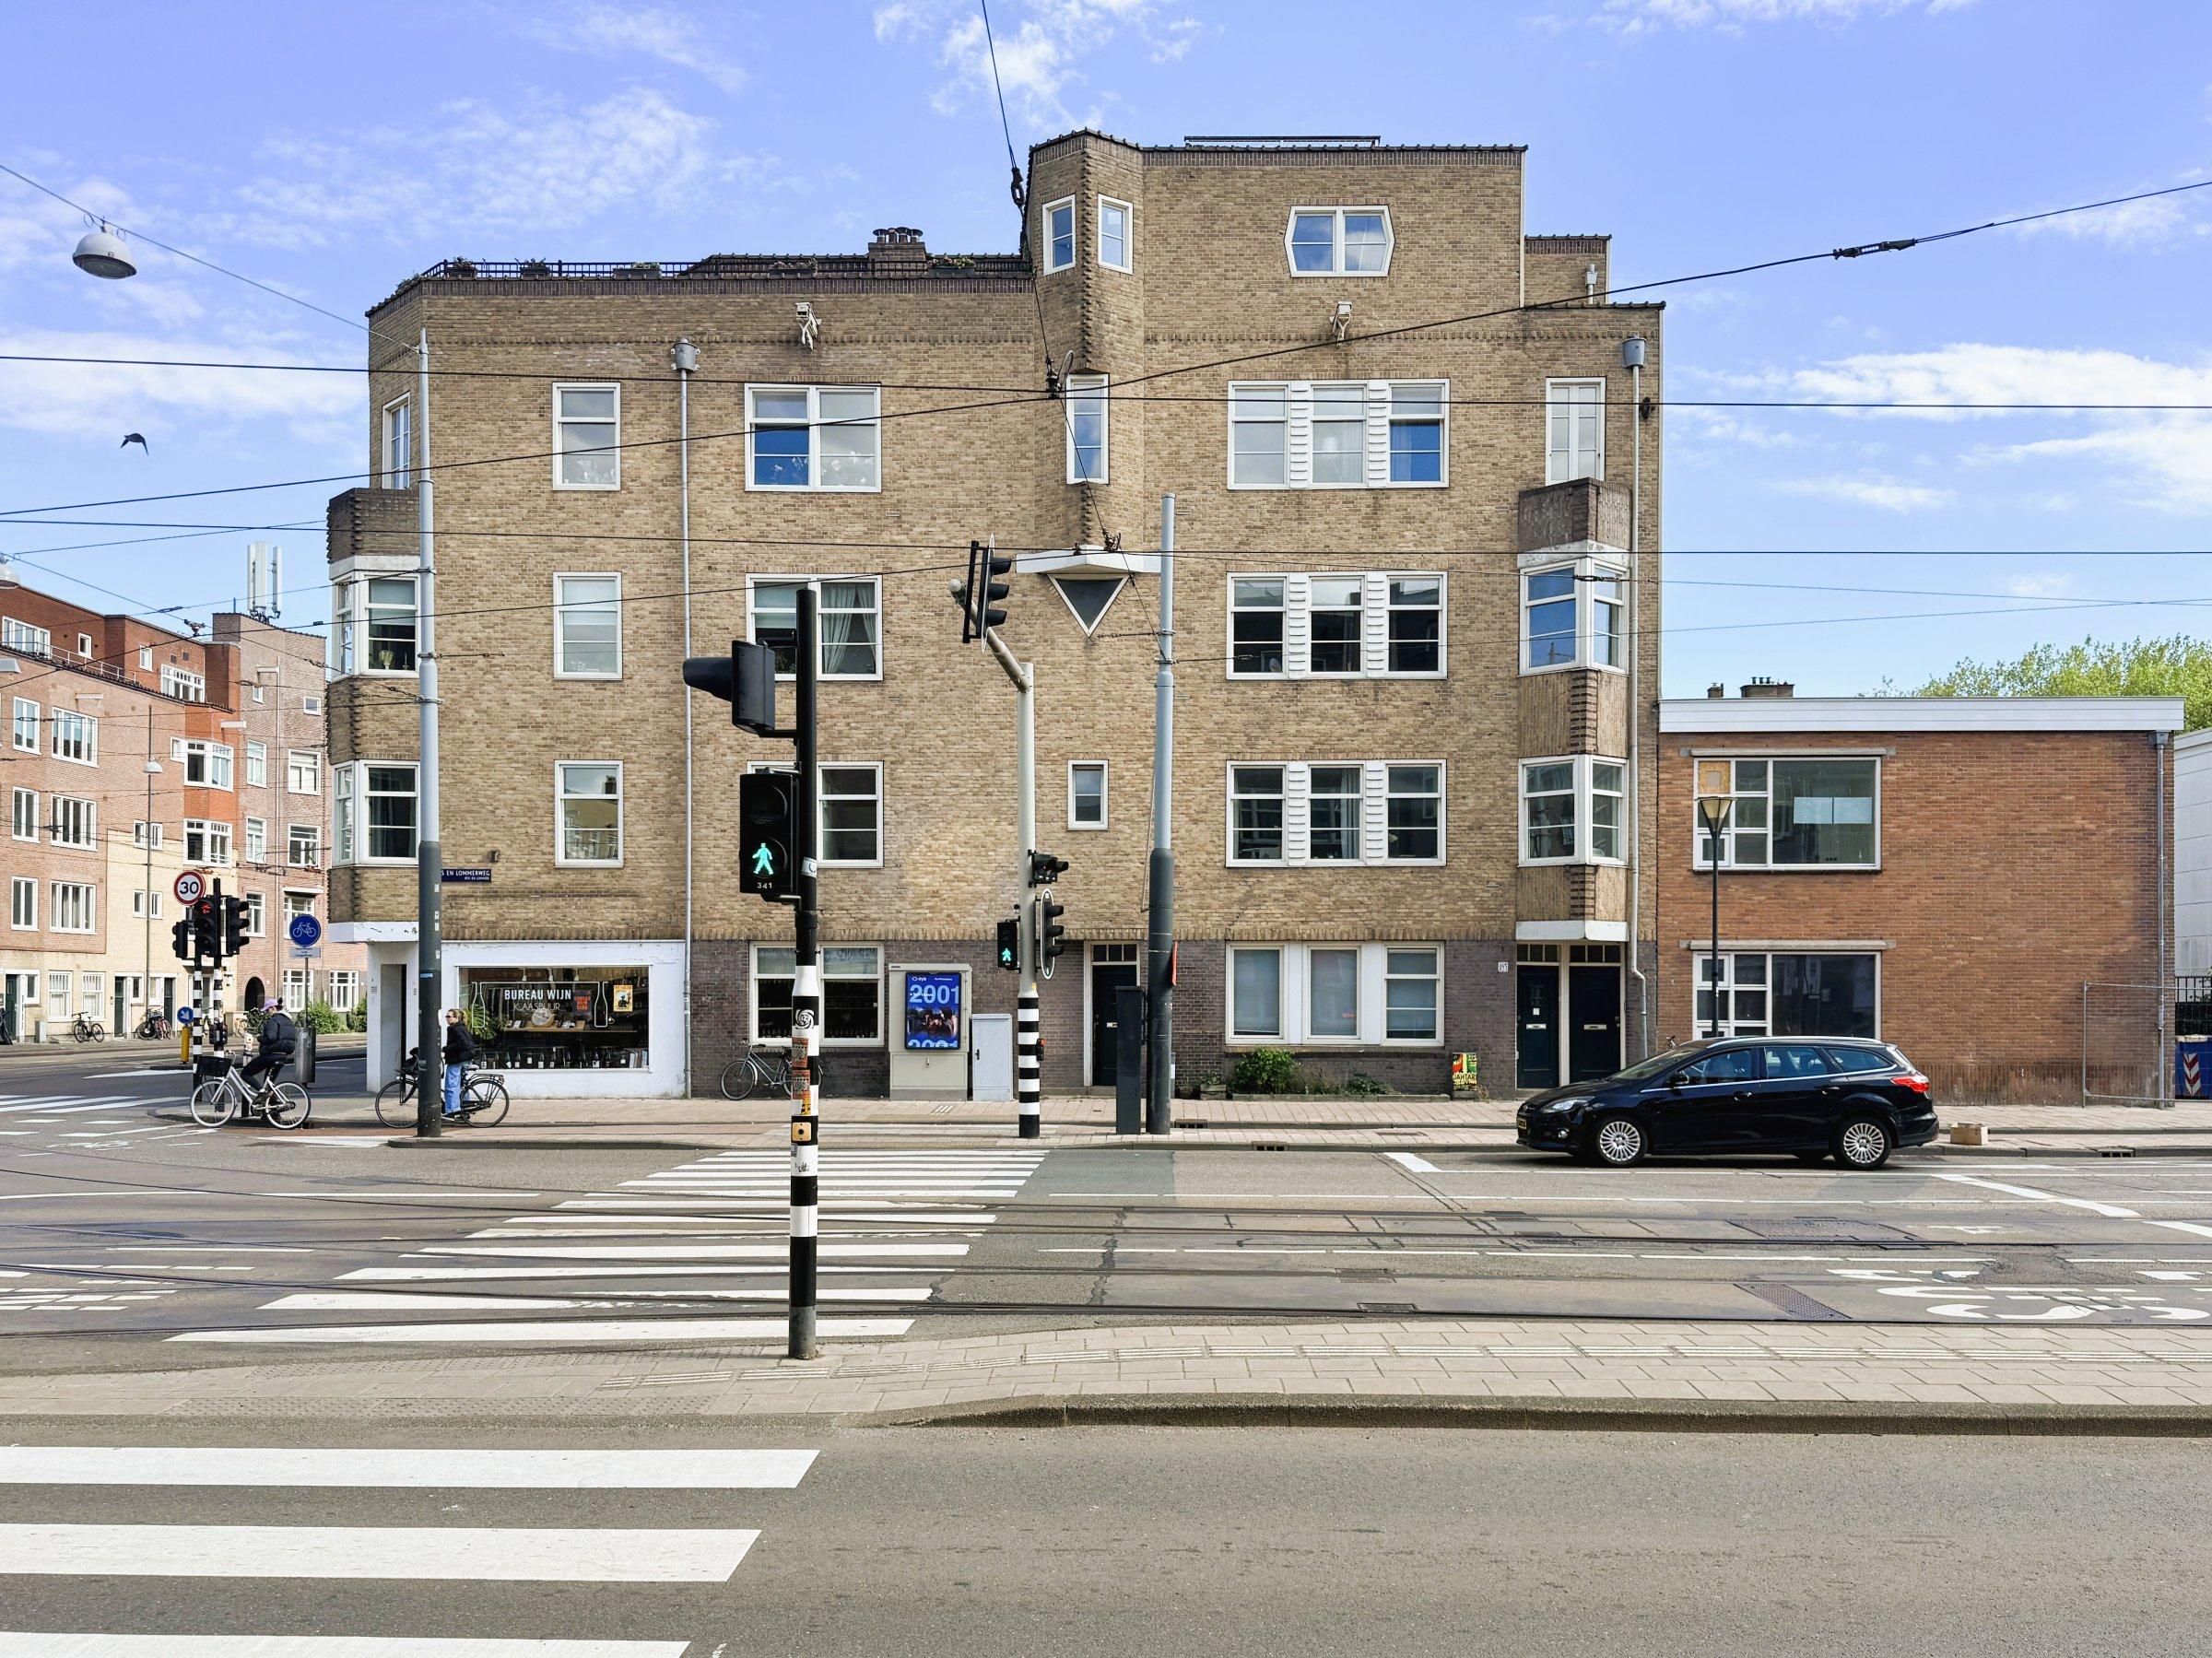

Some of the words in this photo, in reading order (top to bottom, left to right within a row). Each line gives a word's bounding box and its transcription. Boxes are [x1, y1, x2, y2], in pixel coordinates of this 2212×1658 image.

[180, 881, 199, 894] 30
[504, 989, 544, 1000] BUREAU
[547, 989, 571, 1000] WIJN
